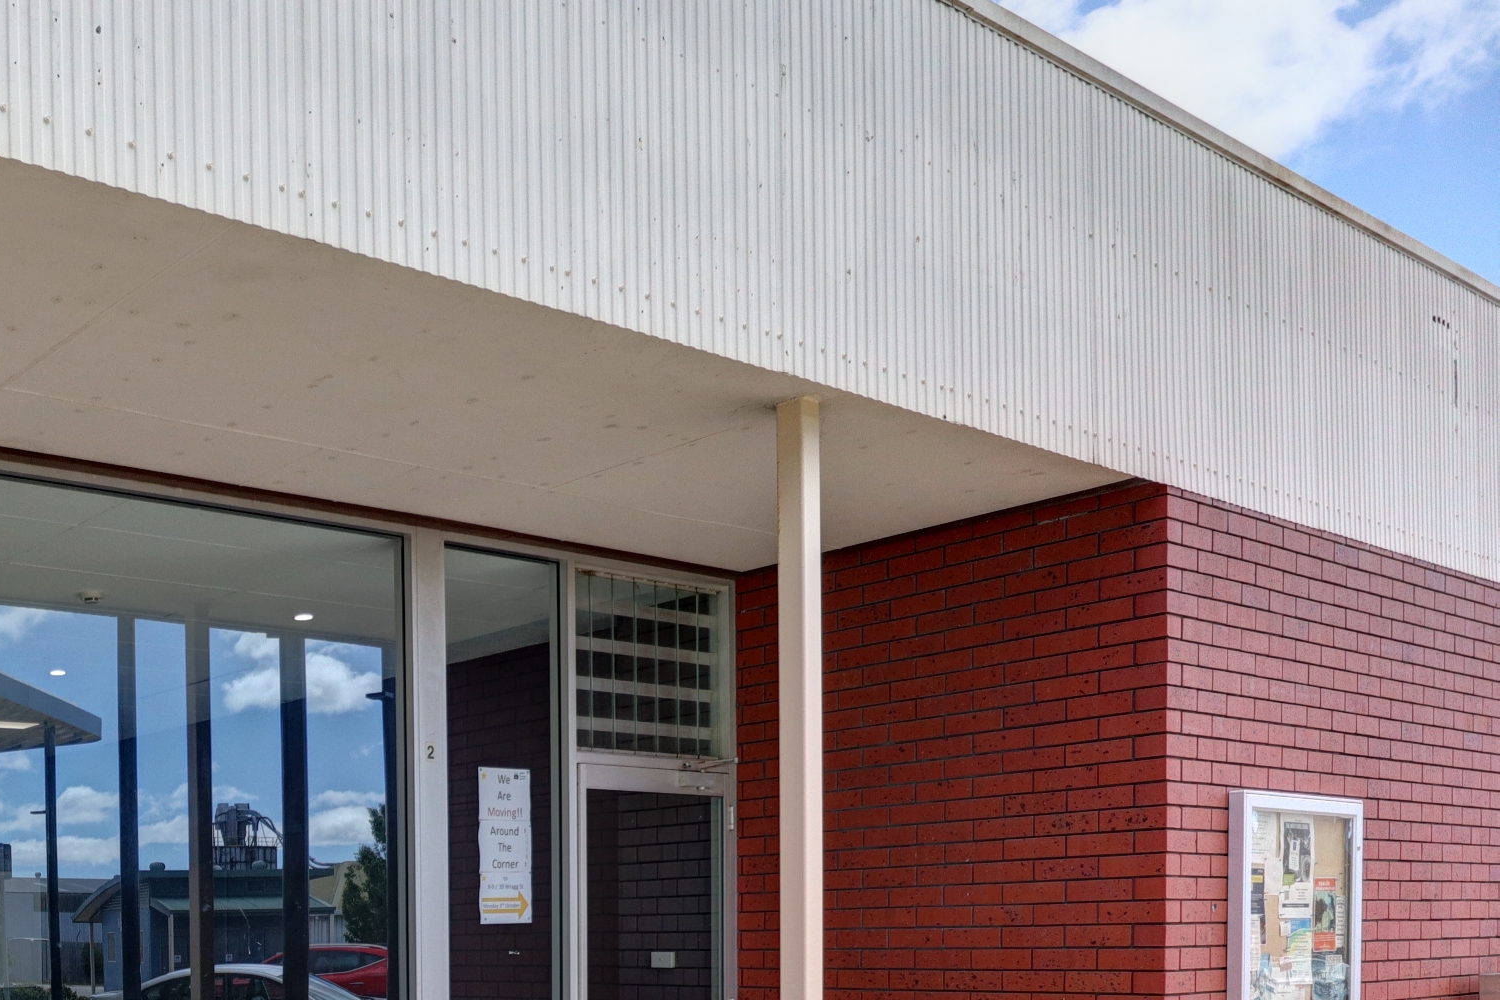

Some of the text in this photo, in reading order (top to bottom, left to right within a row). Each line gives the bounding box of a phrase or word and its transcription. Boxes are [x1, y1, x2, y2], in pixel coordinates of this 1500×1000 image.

[427, 745, 435, 760] 2
[497, 774, 511, 785] We
[497, 791, 512, 801] Are
[487, 807, 523, 820] Moving!!
[490, 826, 520, 836] Around
[497, 842, 512, 853] The
[491, 859, 519, 869] Corner
